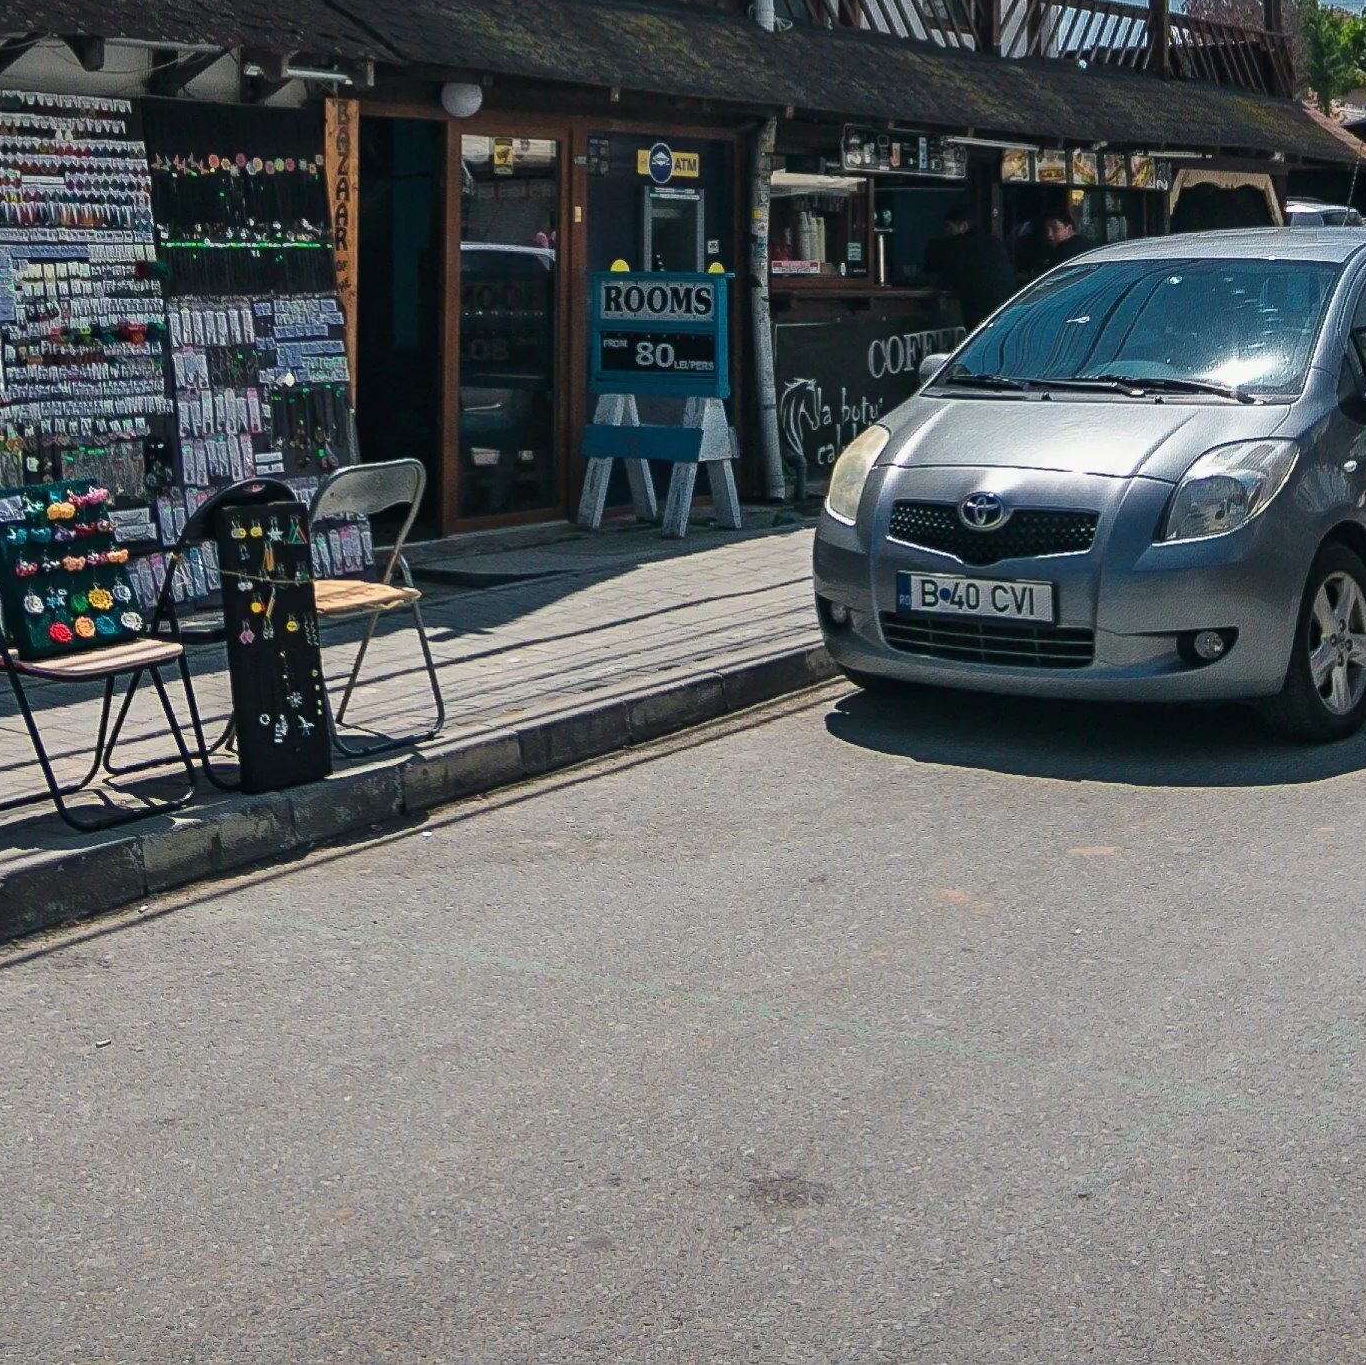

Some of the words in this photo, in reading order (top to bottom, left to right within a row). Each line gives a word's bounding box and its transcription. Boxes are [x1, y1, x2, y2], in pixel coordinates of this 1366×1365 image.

[673, 159, 697, 172] ATM
[603, 286, 712, 315] ROOMS
[603, 338, 628, 348] FROM
[635, 341, 675, 368] 80
[921, 579, 939, 607] B
[949, 582, 980, 610] 40
[991, 584, 1035, 616] CVI
